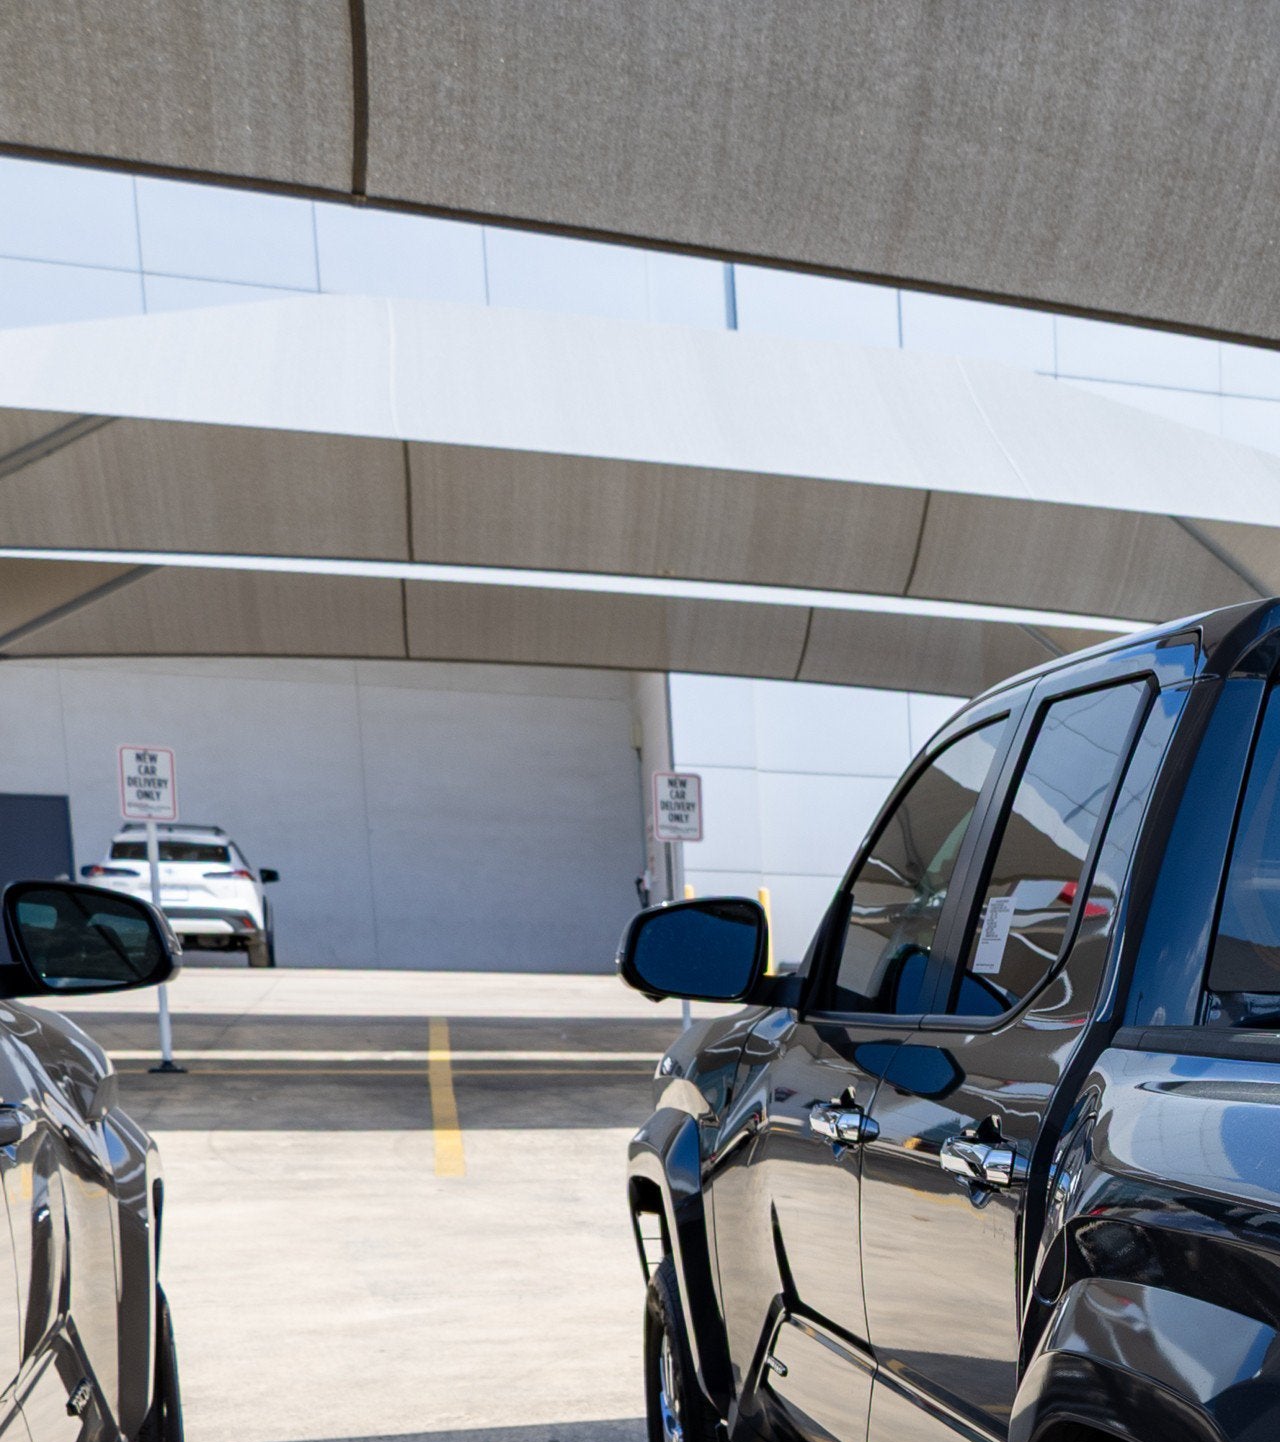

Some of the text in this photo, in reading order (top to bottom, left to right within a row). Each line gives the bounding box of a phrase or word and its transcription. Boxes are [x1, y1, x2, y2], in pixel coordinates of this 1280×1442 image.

[135, 753, 158, 763] NEW
[138, 764, 156, 775] CAR
[127, 776, 169, 789] DELIVERY
[668, 778, 687, 788] NEW
[136, 789, 161, 800] ONLY
[670, 789, 686, 799] CAR
[660, 800, 696, 812] DELIVERY
[668, 812, 690, 823] ONLY
